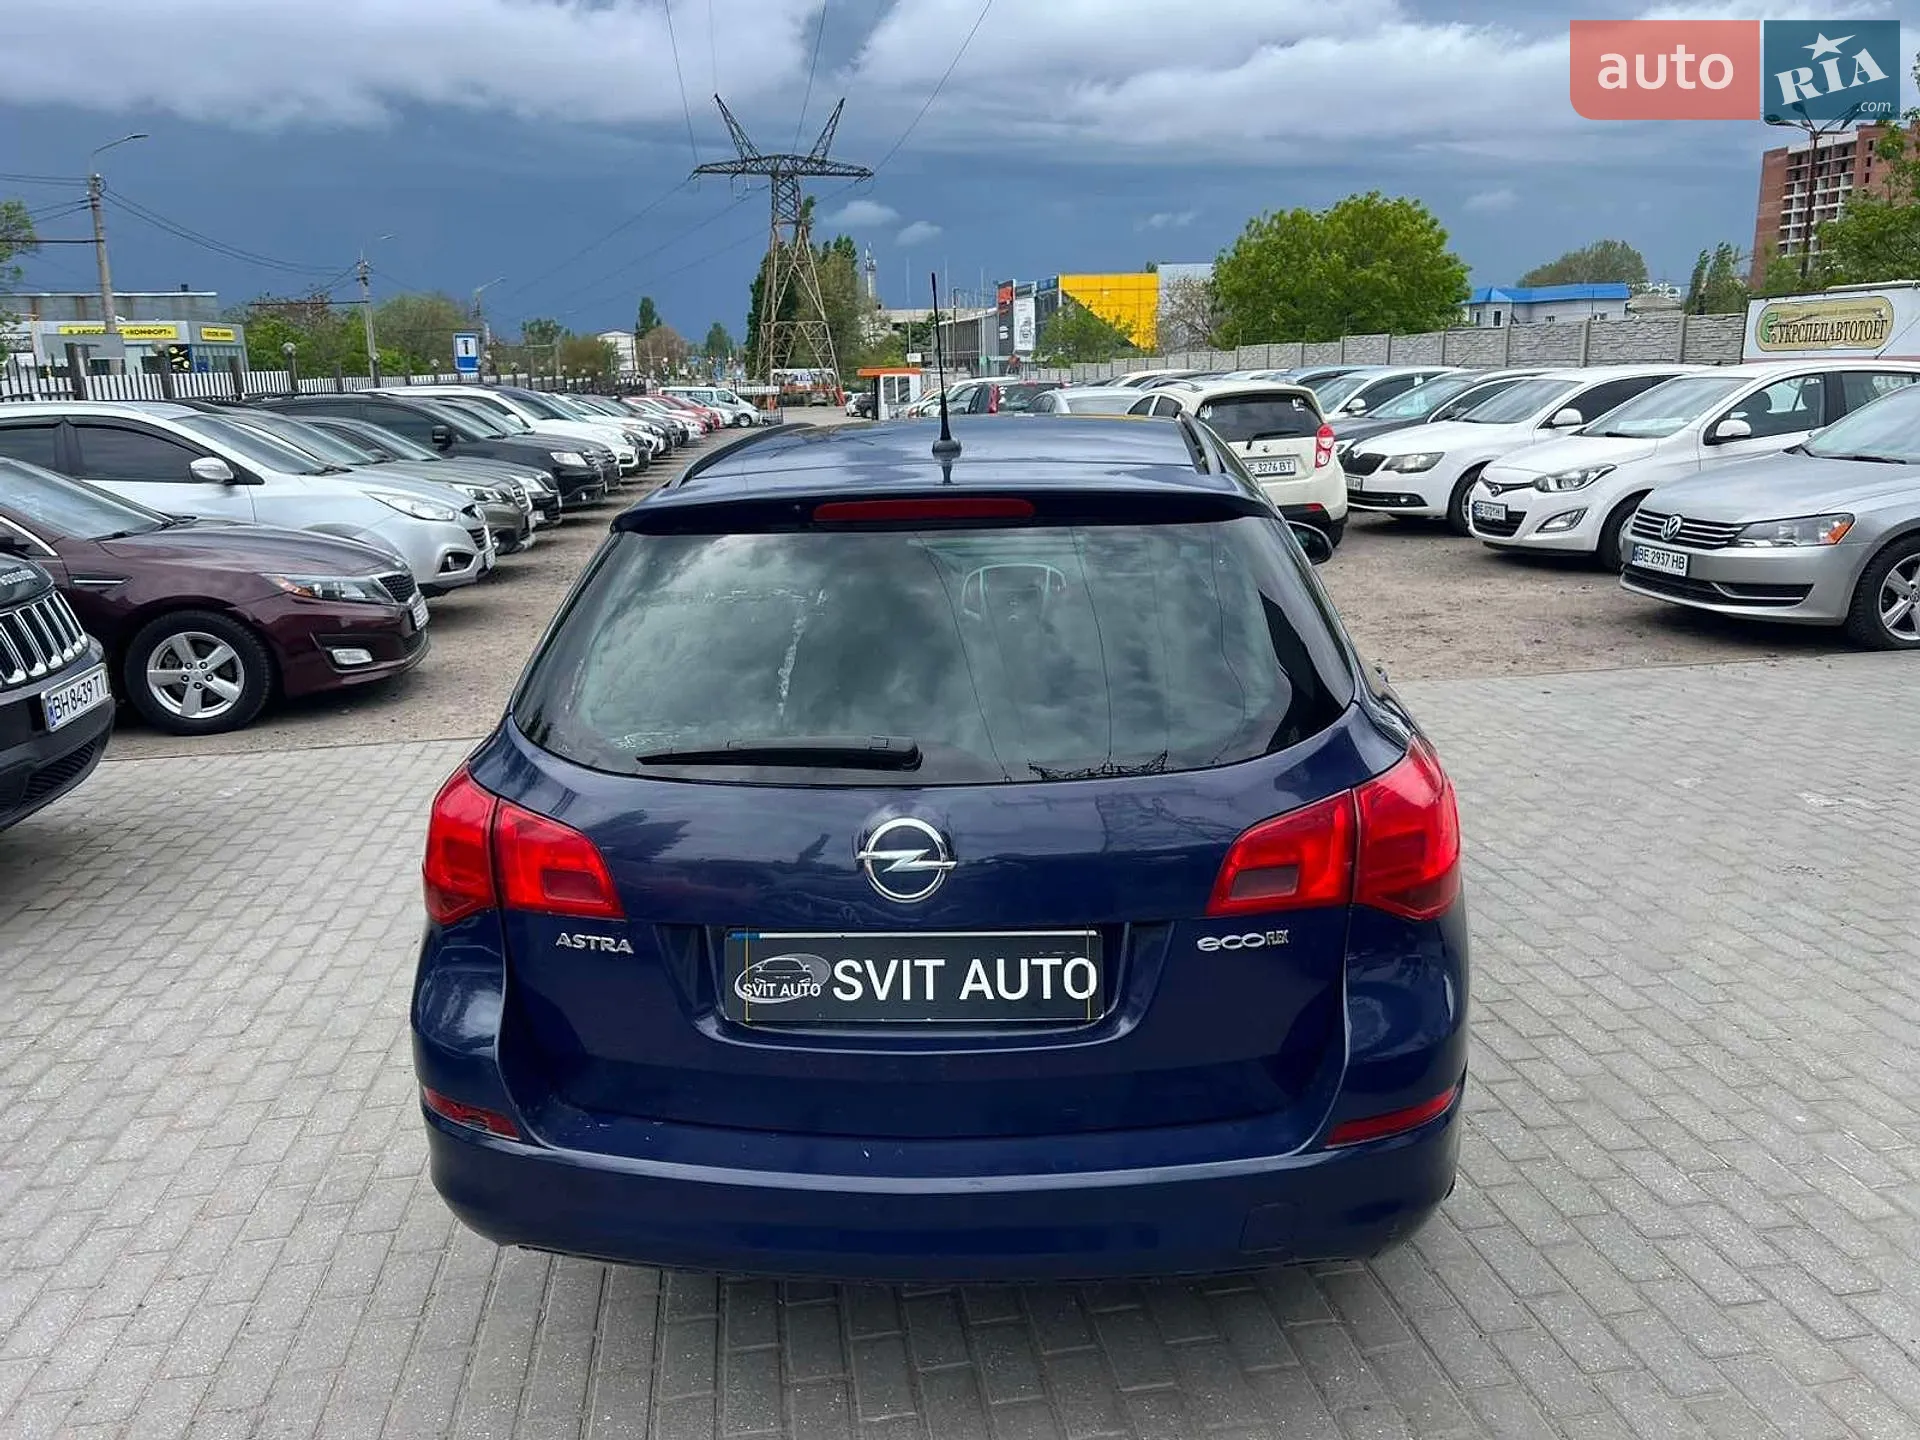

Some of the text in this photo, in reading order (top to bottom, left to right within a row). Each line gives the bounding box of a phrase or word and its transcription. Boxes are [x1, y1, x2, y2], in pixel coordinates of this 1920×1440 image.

[1639, 548, 1650, 562] BE
[1651, 550, 1670, 567] 2937
[1671, 554, 1685, 570] HB
[53, 691, 71, 719] BH
[555, 932, 635, 954] ASTRA
[742, 982, 822, 998] SVIT AUTO
[832, 957, 1098, 1001] SVIT AUTO
